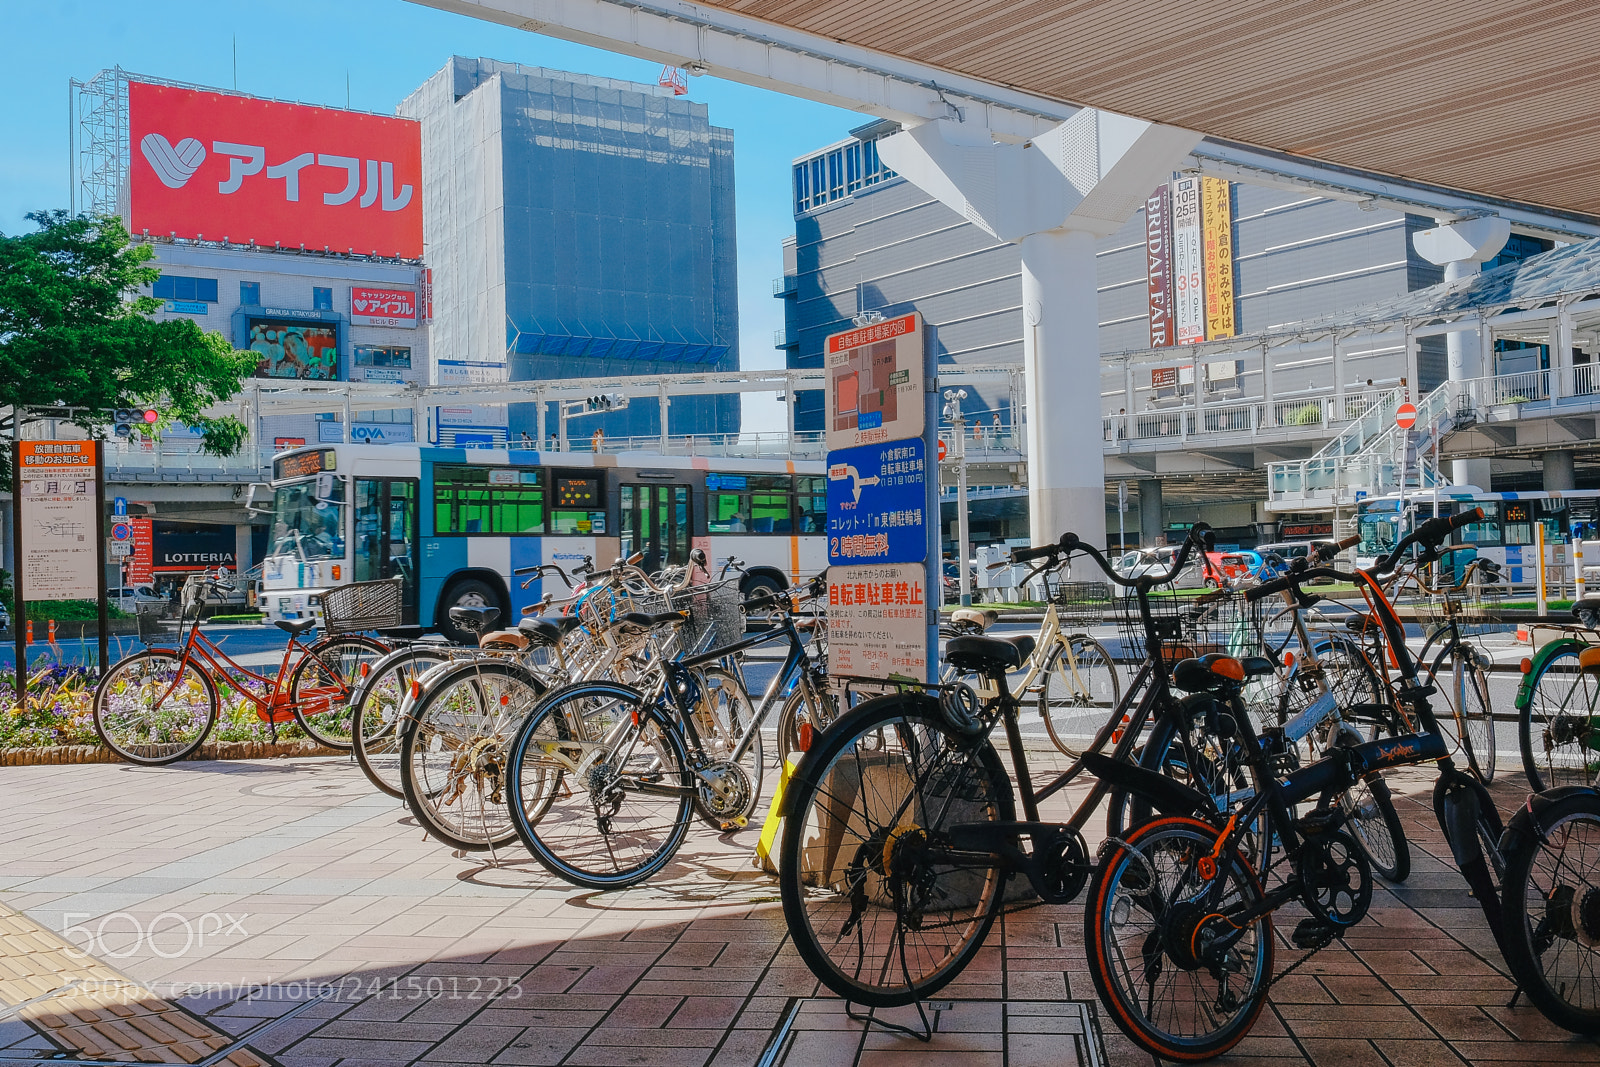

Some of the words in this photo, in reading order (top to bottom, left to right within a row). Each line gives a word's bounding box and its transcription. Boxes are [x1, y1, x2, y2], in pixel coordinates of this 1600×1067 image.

[213, 140, 413, 212] アイフル
[1176, 190, 1195, 204] 10日
[1176, 203, 1197, 218] 25日
[1148, 195, 1163, 286] BRIDAL
[361, 292, 407, 301] キャッシングなら
[291, 310, 321, 319] KITAKYUSHU
[369, 300, 413, 315] アイフル
[1150, 290, 1166, 348] FAIR
[838, 320, 906, 349] 自転車駐車場案内図
[351, 427, 385, 439] NOVA
[855, 428, 888, 444] 2時間無料
[34, 444, 82, 454] 放置自転車
[880, 446, 916, 462] 小倉駅南口
[25, 455, 89, 465] 移動のお知らせ
[881, 458, 924, 476] 自転車駐車場
[830, 532, 889, 558] 2時間無料
[165, 553, 233, 563] LOTTERIA
[846, 568, 902, 580] 北九州市からのお願い
[829, 581, 924, 606] 自転車駐車禁止
